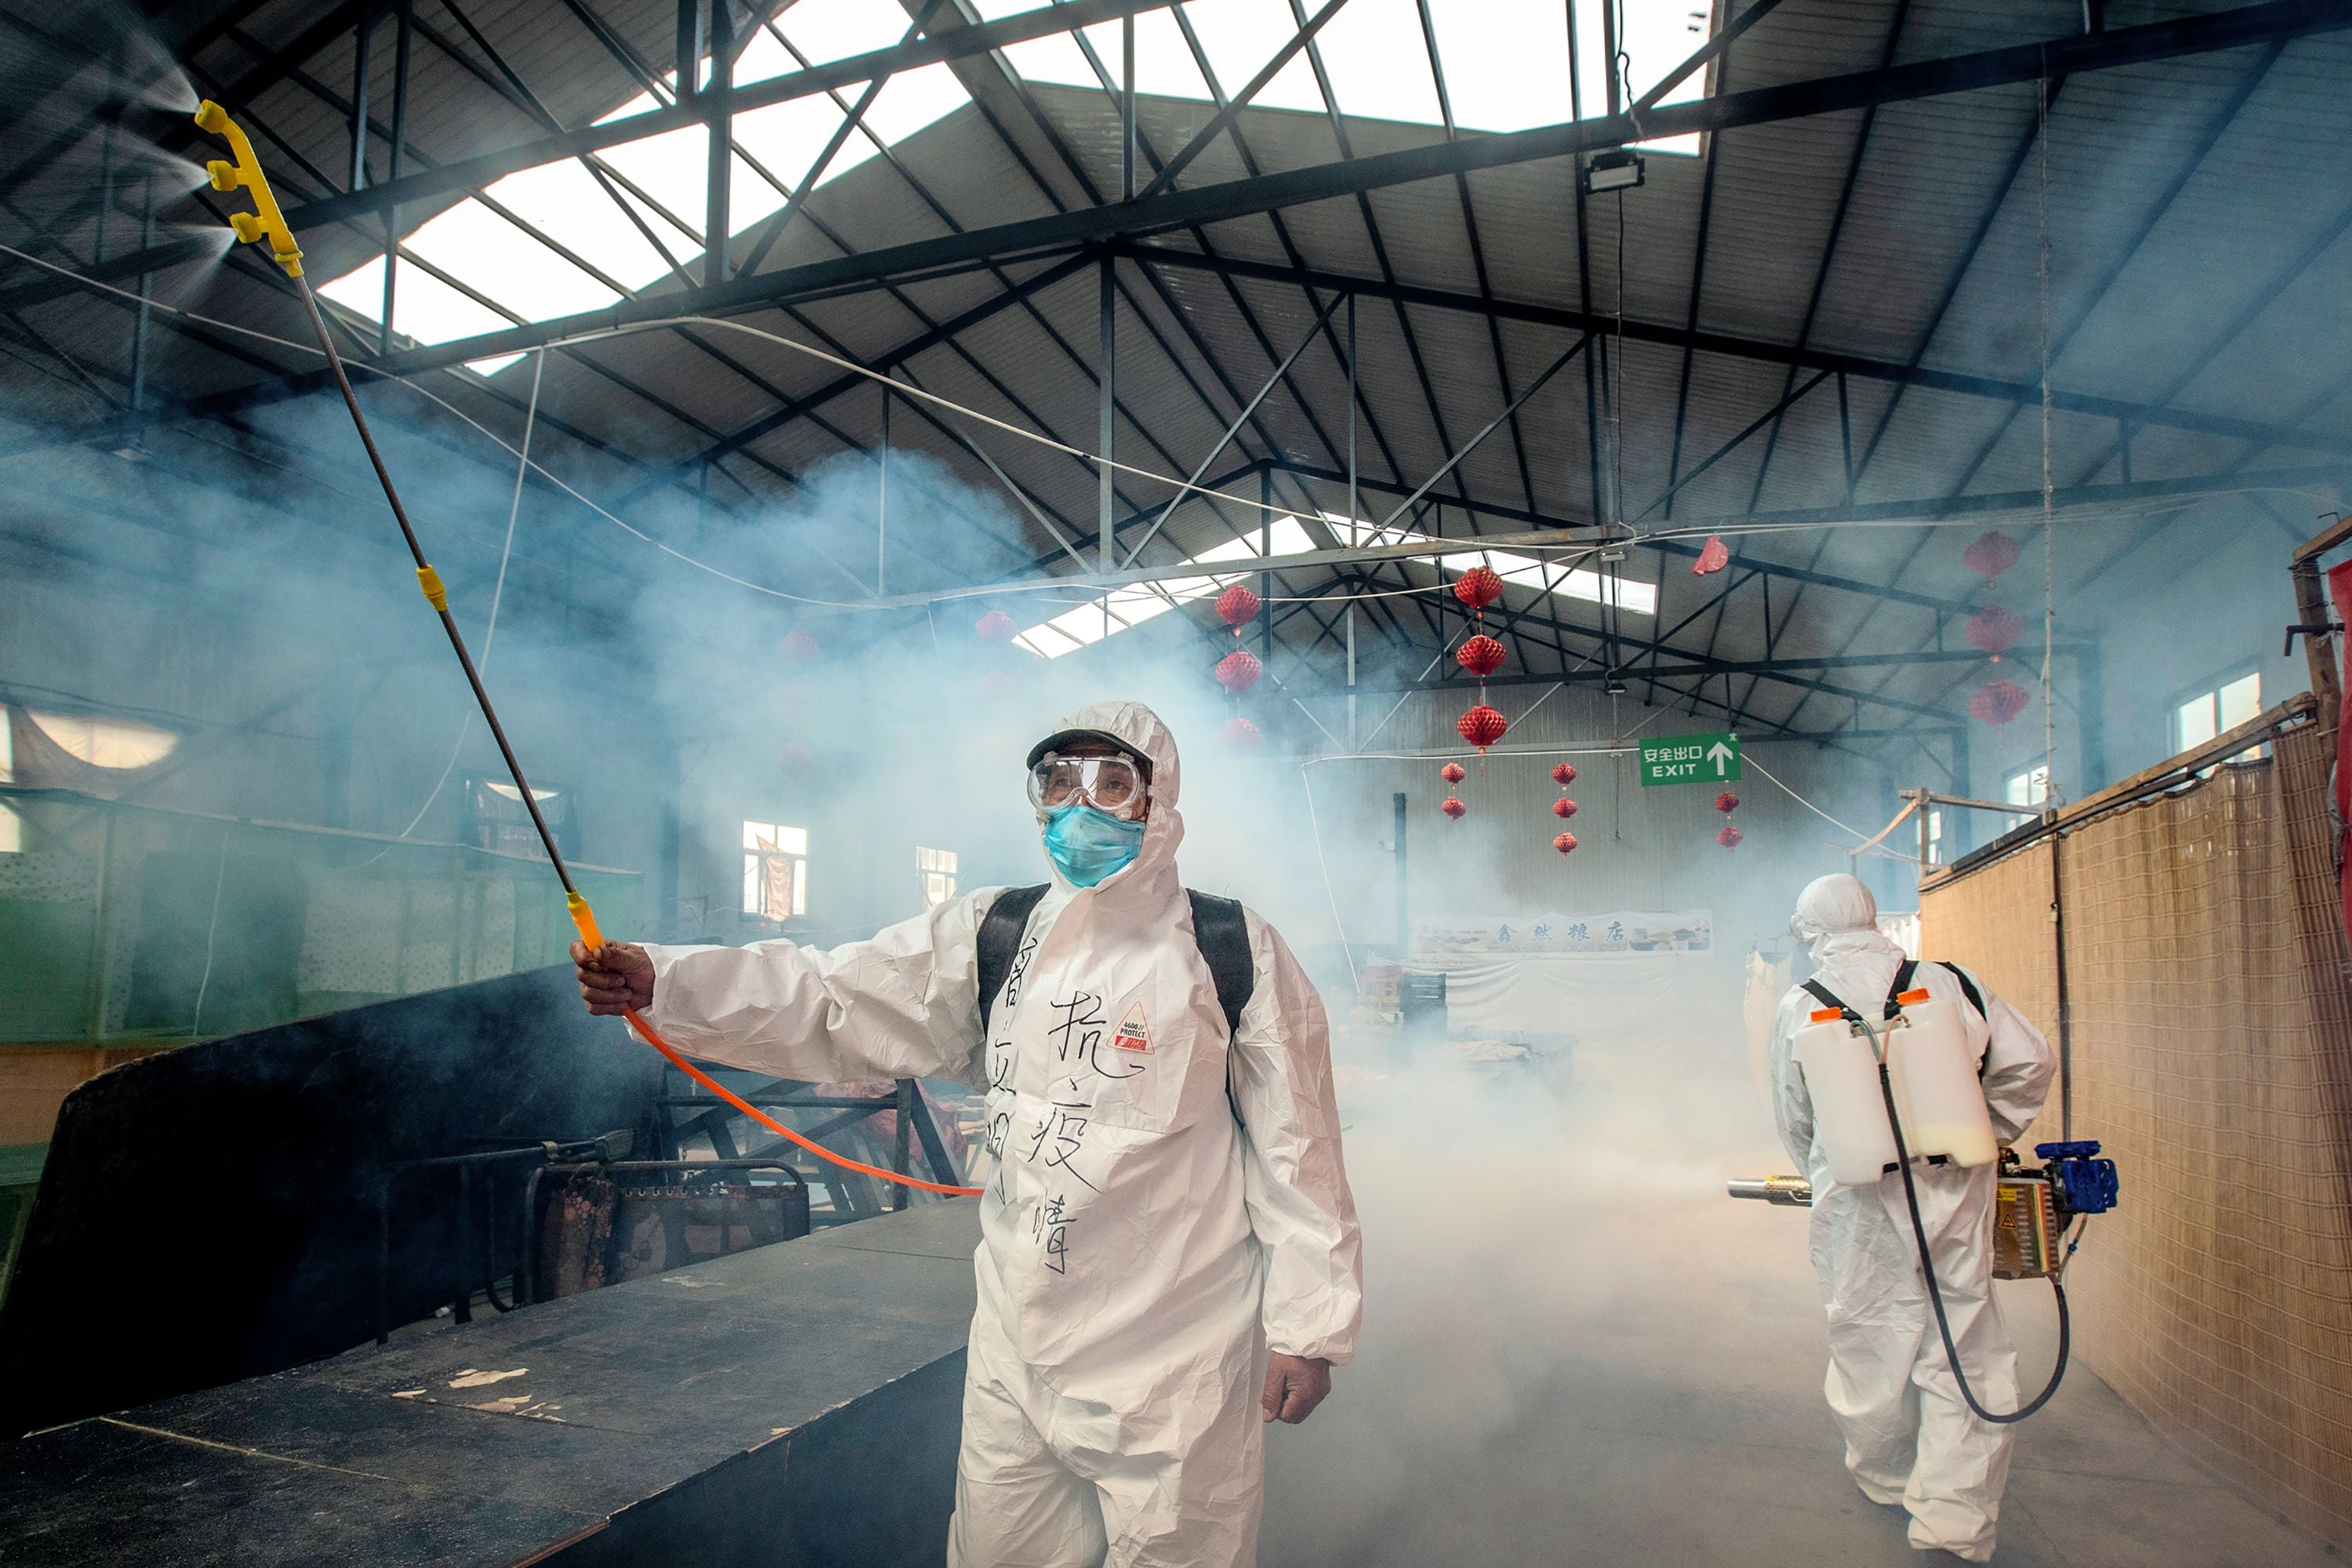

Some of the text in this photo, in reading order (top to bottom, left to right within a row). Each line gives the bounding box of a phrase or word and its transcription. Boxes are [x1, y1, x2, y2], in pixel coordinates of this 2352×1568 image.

[1644, 746, 1703, 763] 安全出口
[1652, 764, 1697, 778] EXIT
[1120, 1028, 1145, 1038] PROTECT
